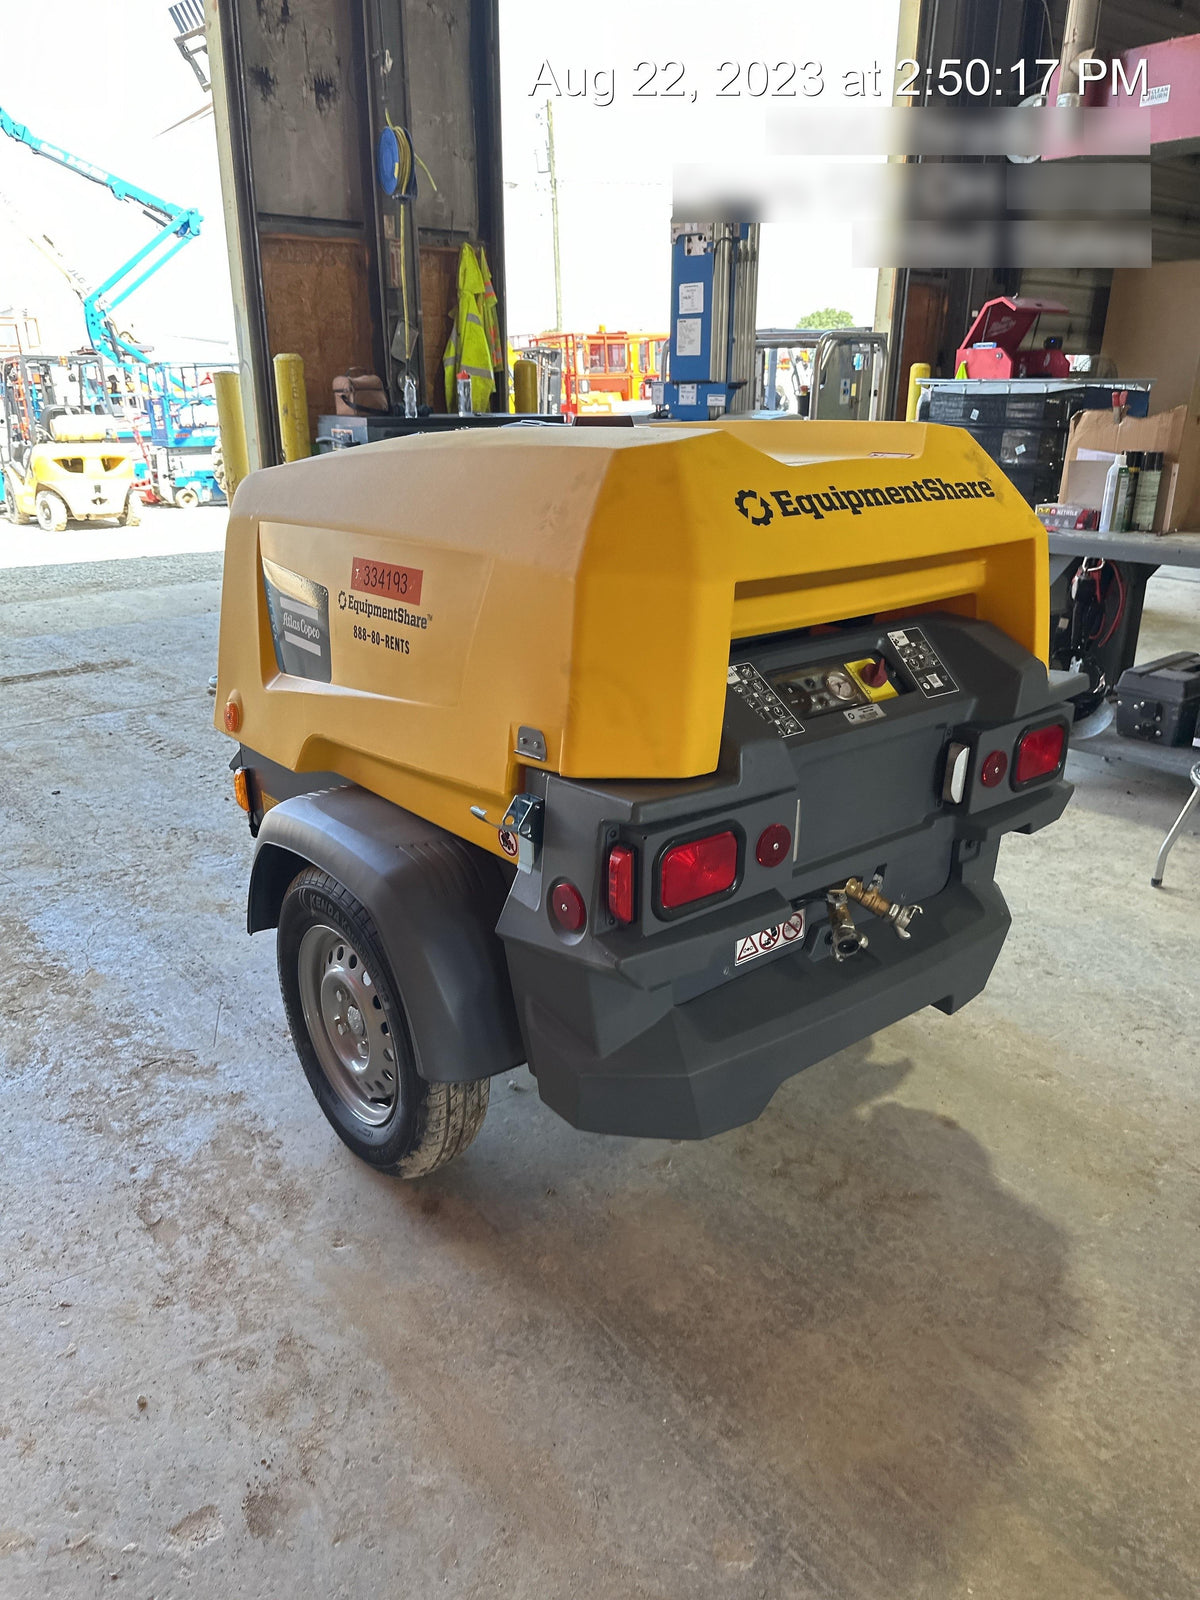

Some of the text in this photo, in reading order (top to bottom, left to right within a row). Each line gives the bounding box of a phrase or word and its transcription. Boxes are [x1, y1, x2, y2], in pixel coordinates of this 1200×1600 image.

[770, 477, 995, 520] EquipmentShare
[363, 565, 408, 595] 334193
[282, 612, 320, 639] Atlas Copco
[348, 594, 428, 630] EquipmentShare
[353, 625, 410, 655] 888-80-RENTS
